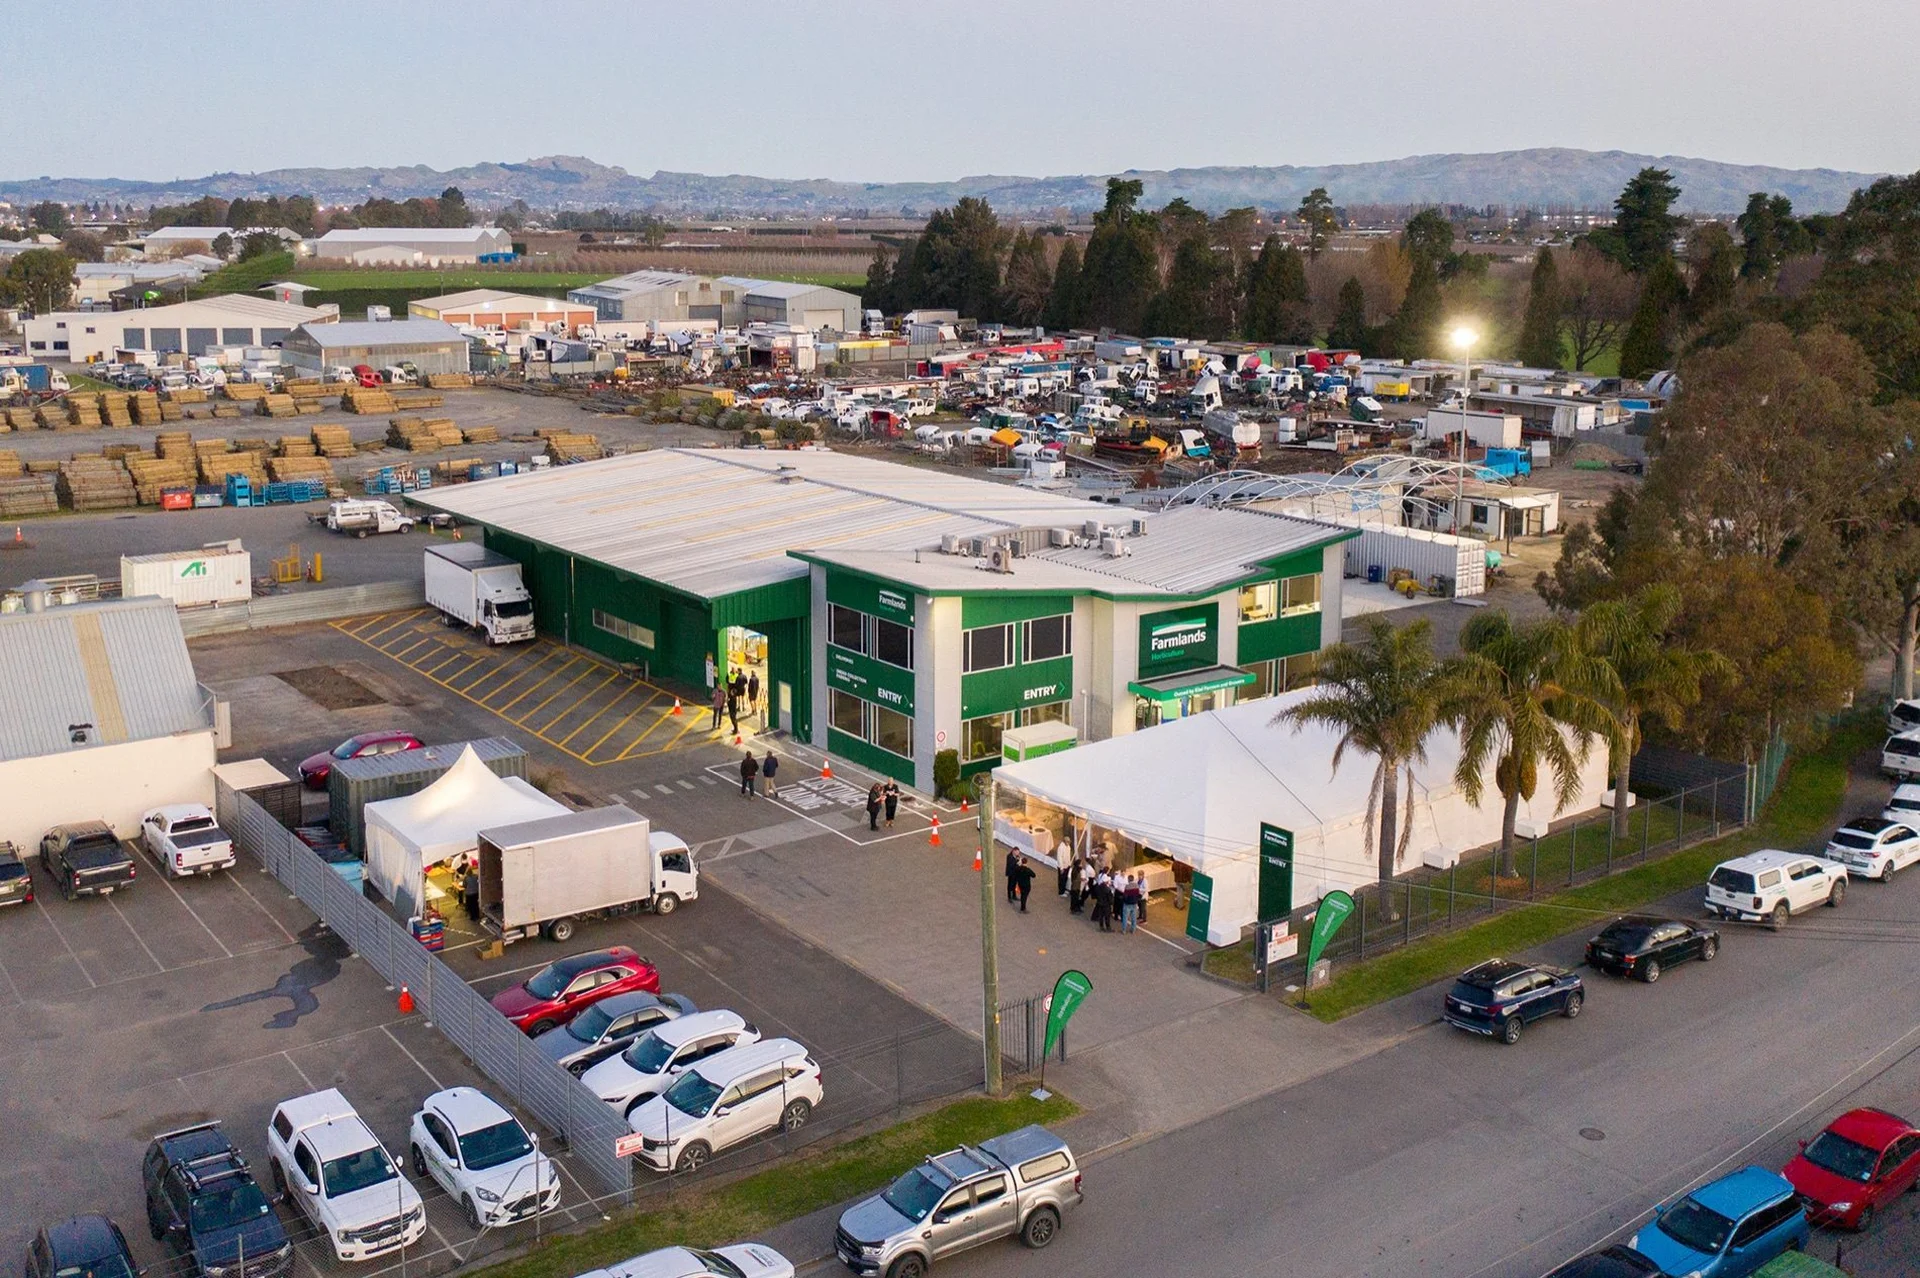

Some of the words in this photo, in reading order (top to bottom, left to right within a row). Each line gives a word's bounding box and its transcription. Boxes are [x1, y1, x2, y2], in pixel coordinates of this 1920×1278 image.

[879, 595, 906, 610] Farmlands
[1151, 629, 1207, 651] Farmlands
[877, 687, 902, 704] ENTRY
[1024, 684, 1057, 700] ENTRY
